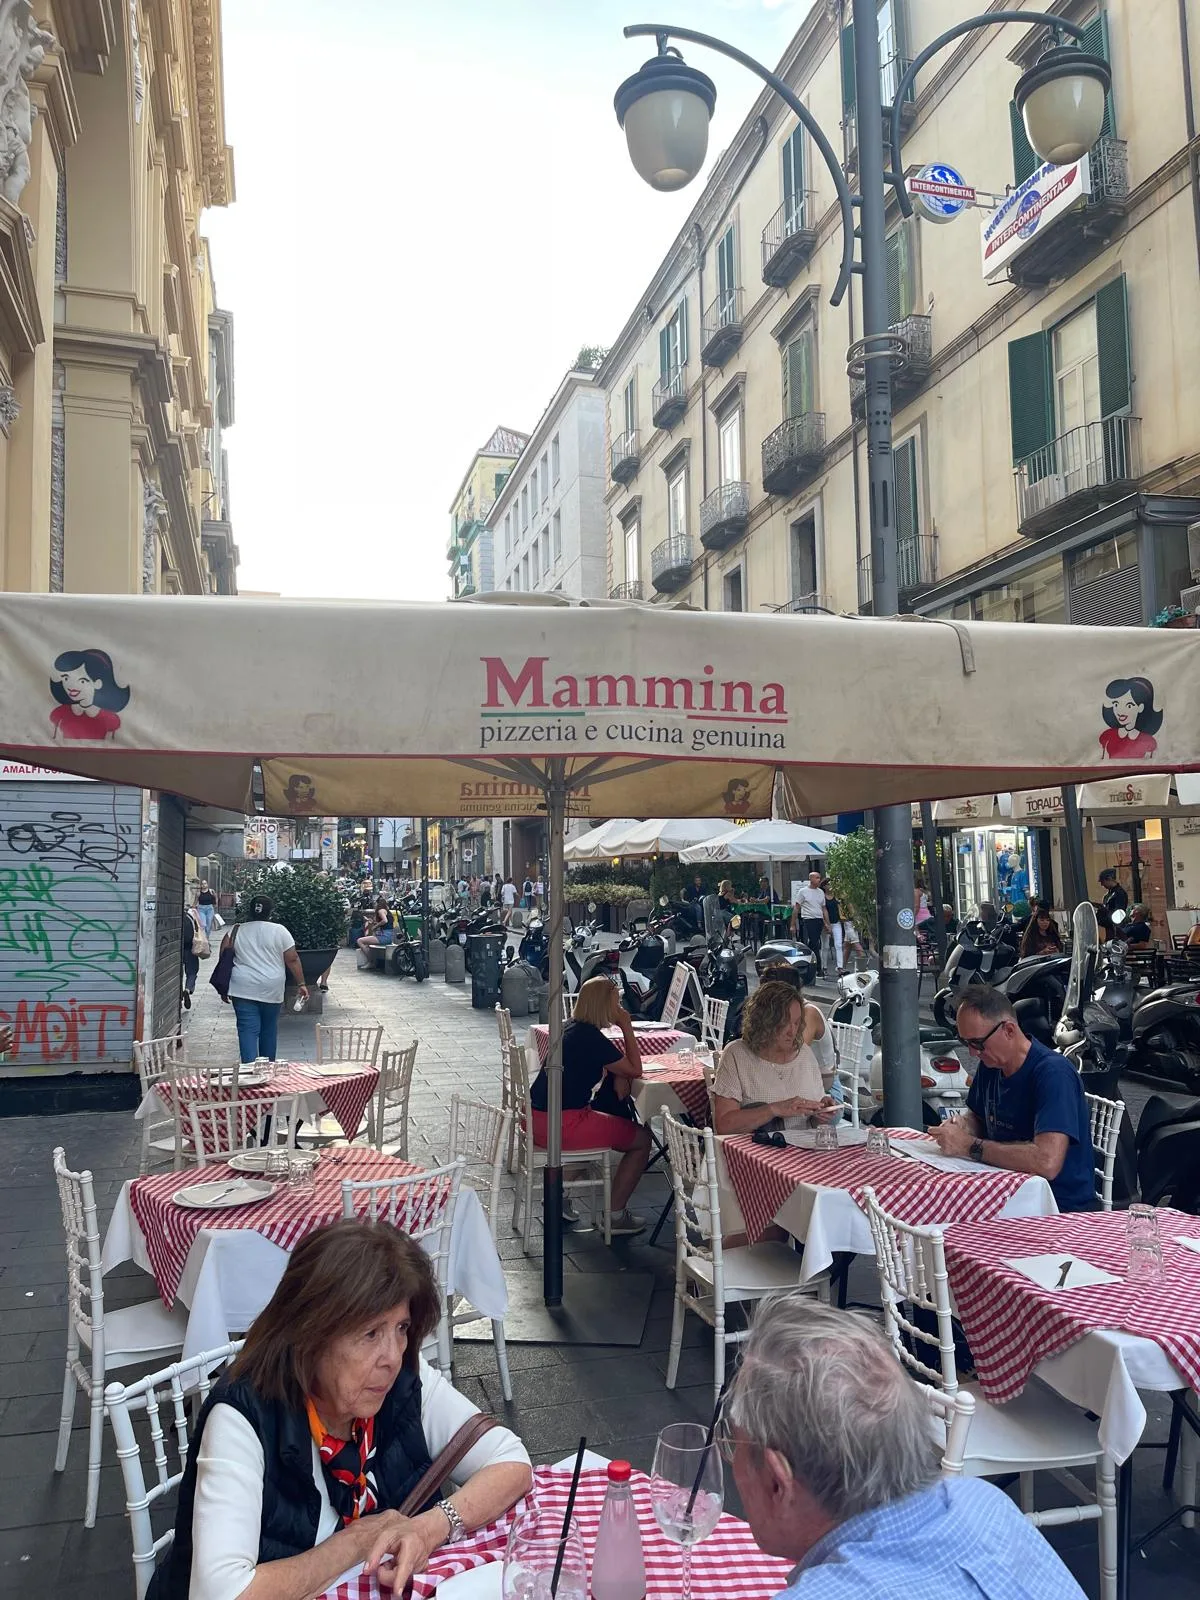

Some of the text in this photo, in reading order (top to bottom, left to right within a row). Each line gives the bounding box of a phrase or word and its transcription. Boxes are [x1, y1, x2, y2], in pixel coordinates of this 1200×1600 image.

[912, 181, 974, 199] INTERCONTINENTAL
[984, 170, 1042, 241] INVESTIGAZIONI
[992, 178, 1069, 251] INTERCONTINENTAL
[479, 656, 788, 715] Mammina
[479, 718, 786, 751] pizzeria e cucina genuina
[2, 765, 41, 774] AMALFI
[250, 823, 276, 833] CIRO
